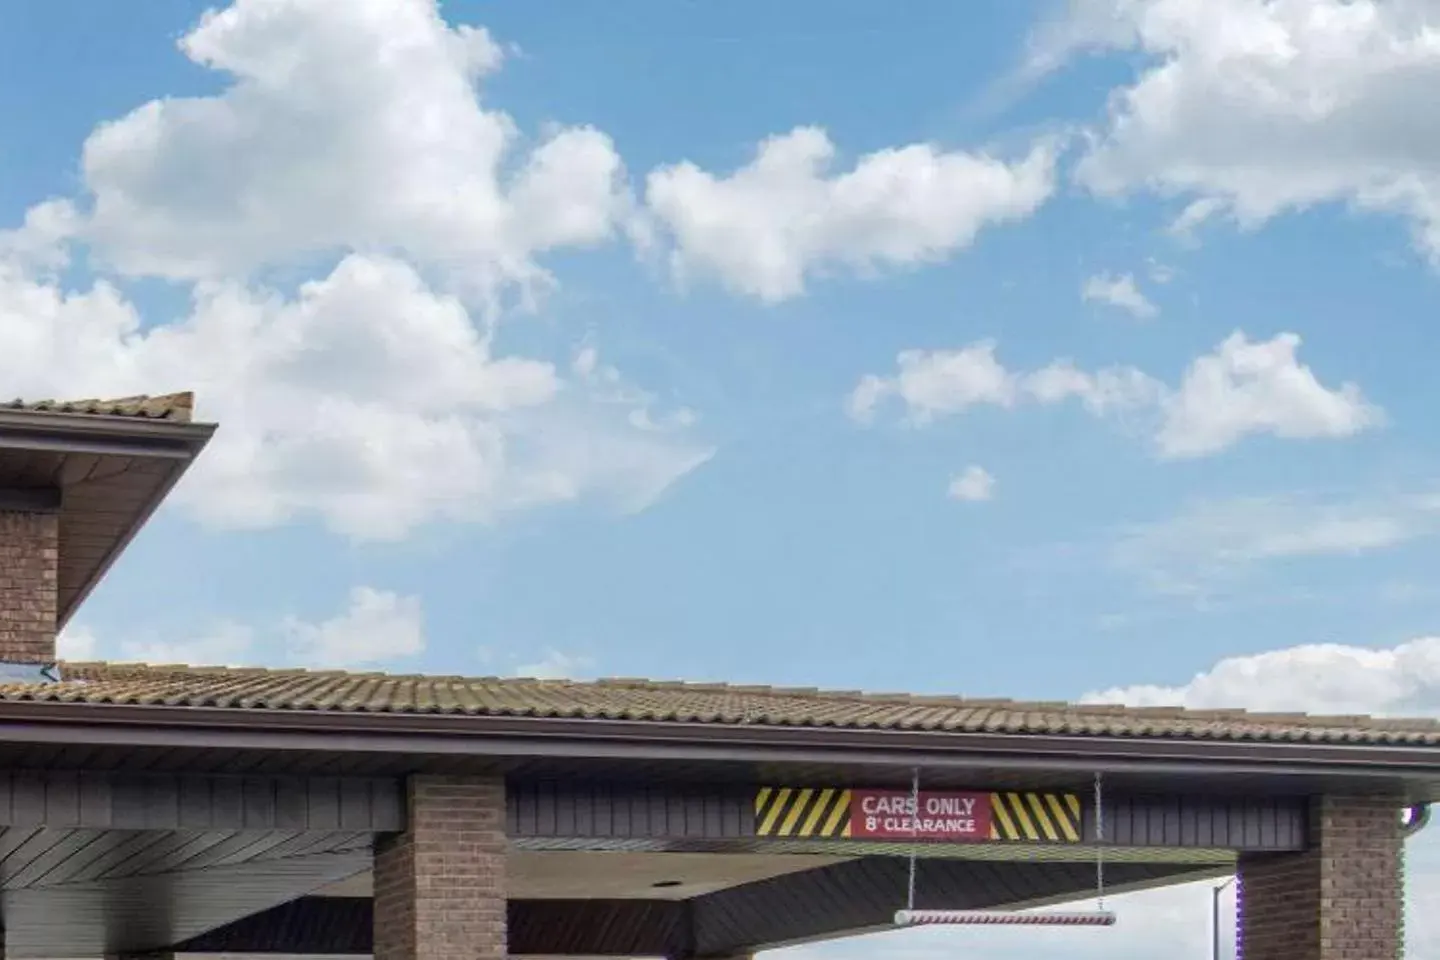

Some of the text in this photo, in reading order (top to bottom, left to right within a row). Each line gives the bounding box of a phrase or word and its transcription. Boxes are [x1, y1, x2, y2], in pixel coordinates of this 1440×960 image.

[862, 796, 976, 816] CARS ONLY
[865, 816, 976, 832] 8' CLEARANCE
